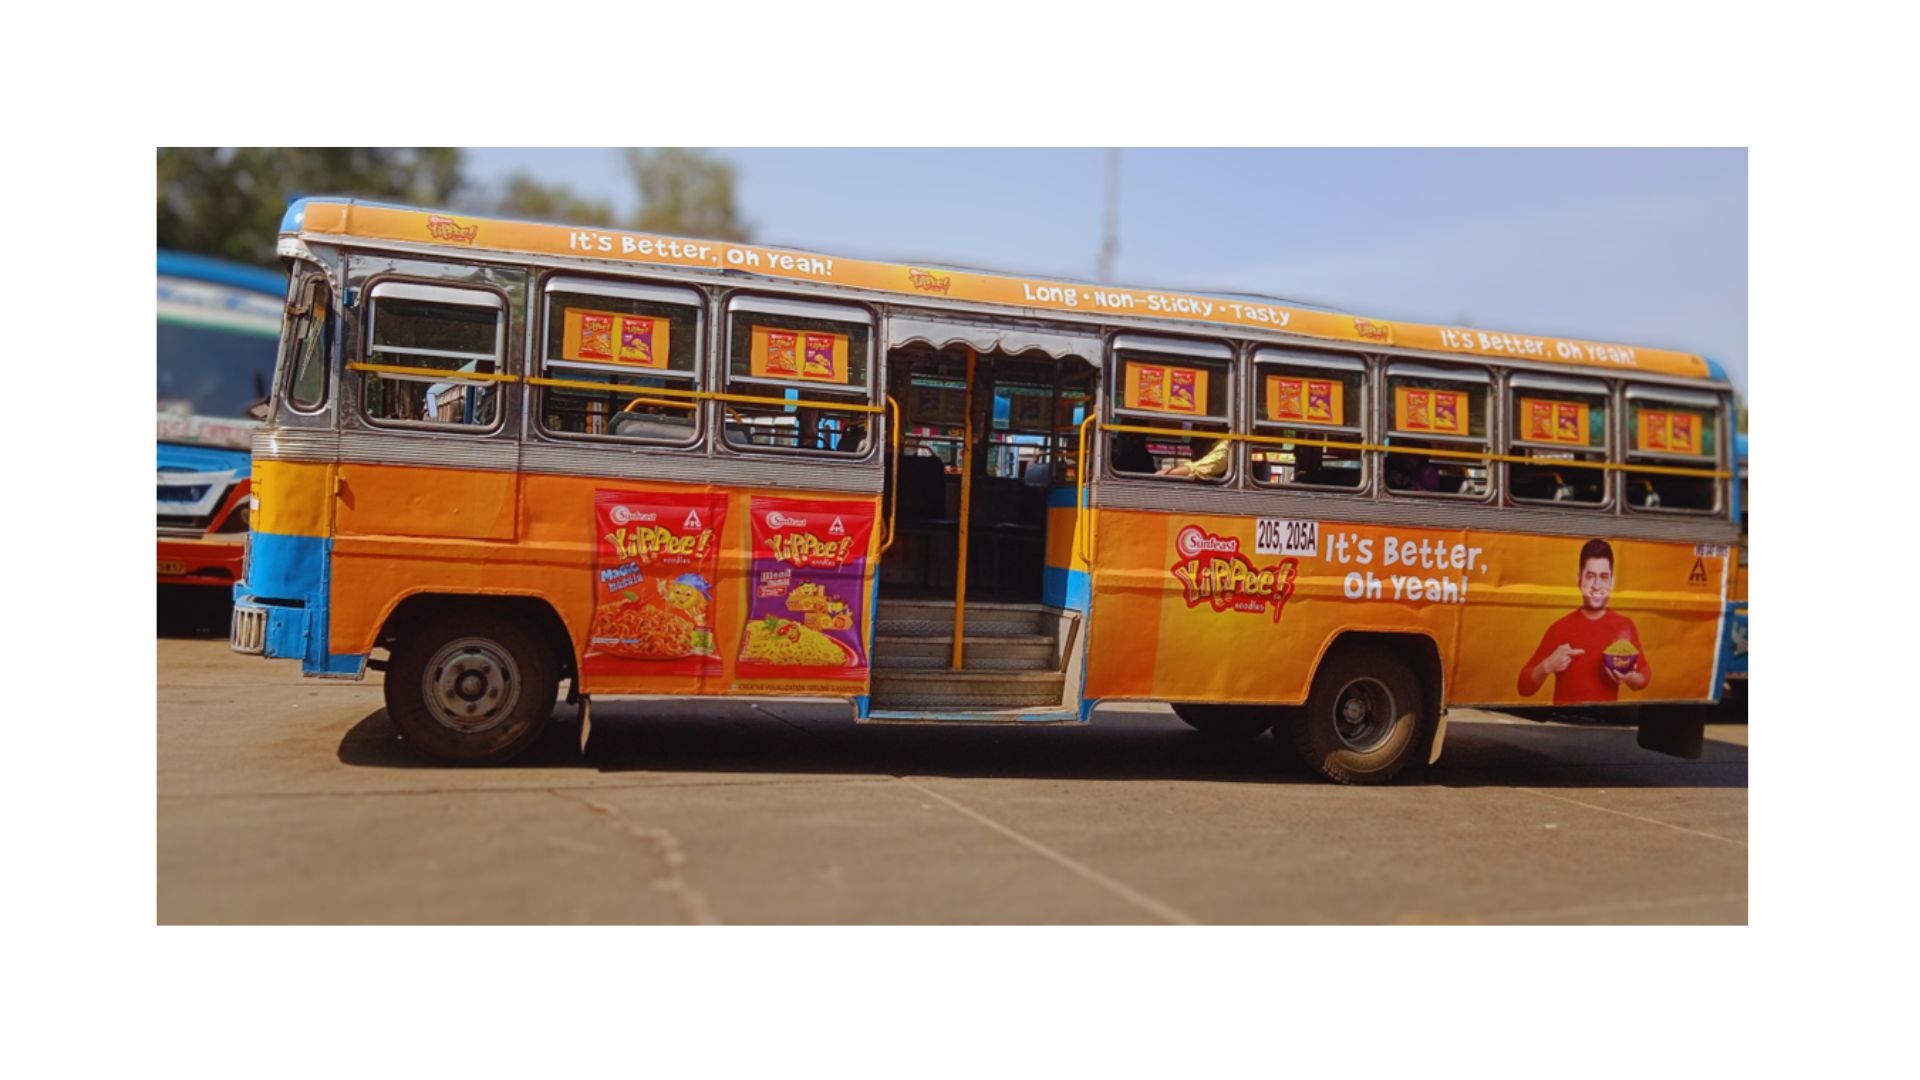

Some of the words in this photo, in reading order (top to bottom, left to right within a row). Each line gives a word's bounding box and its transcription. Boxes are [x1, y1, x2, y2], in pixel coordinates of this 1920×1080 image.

[570, 232, 612, 252] It's
[622, 236, 718, 262] Better,
[726, 248, 759, 267] Oh
[766, 252, 833, 275] Yeah!
[1023, 283, 1077, 306] Long
[1094, 290, 1213, 317] Non-Sticky
[1230, 303, 1291, 326] Tasty
[1440, 329, 1473, 348] It's
[1478, 332, 1552, 357] Better,
[1556, 341, 1583, 359] Oh
[1587, 344, 1637, 365] Yeah!
[1190, 535, 1238, 552] Sunfeast
[1258, 520, 1283, 552] 205,
[1286, 522, 1316, 550] 205A
[1325, 533, 1374, 564] It's
[1383, 536, 1488, 574] Better,
[1344, 571, 1382, 599] Oh
[1390, 574, 1468, 604] Yeah!
[1234, 600, 1265, 611] noodles
